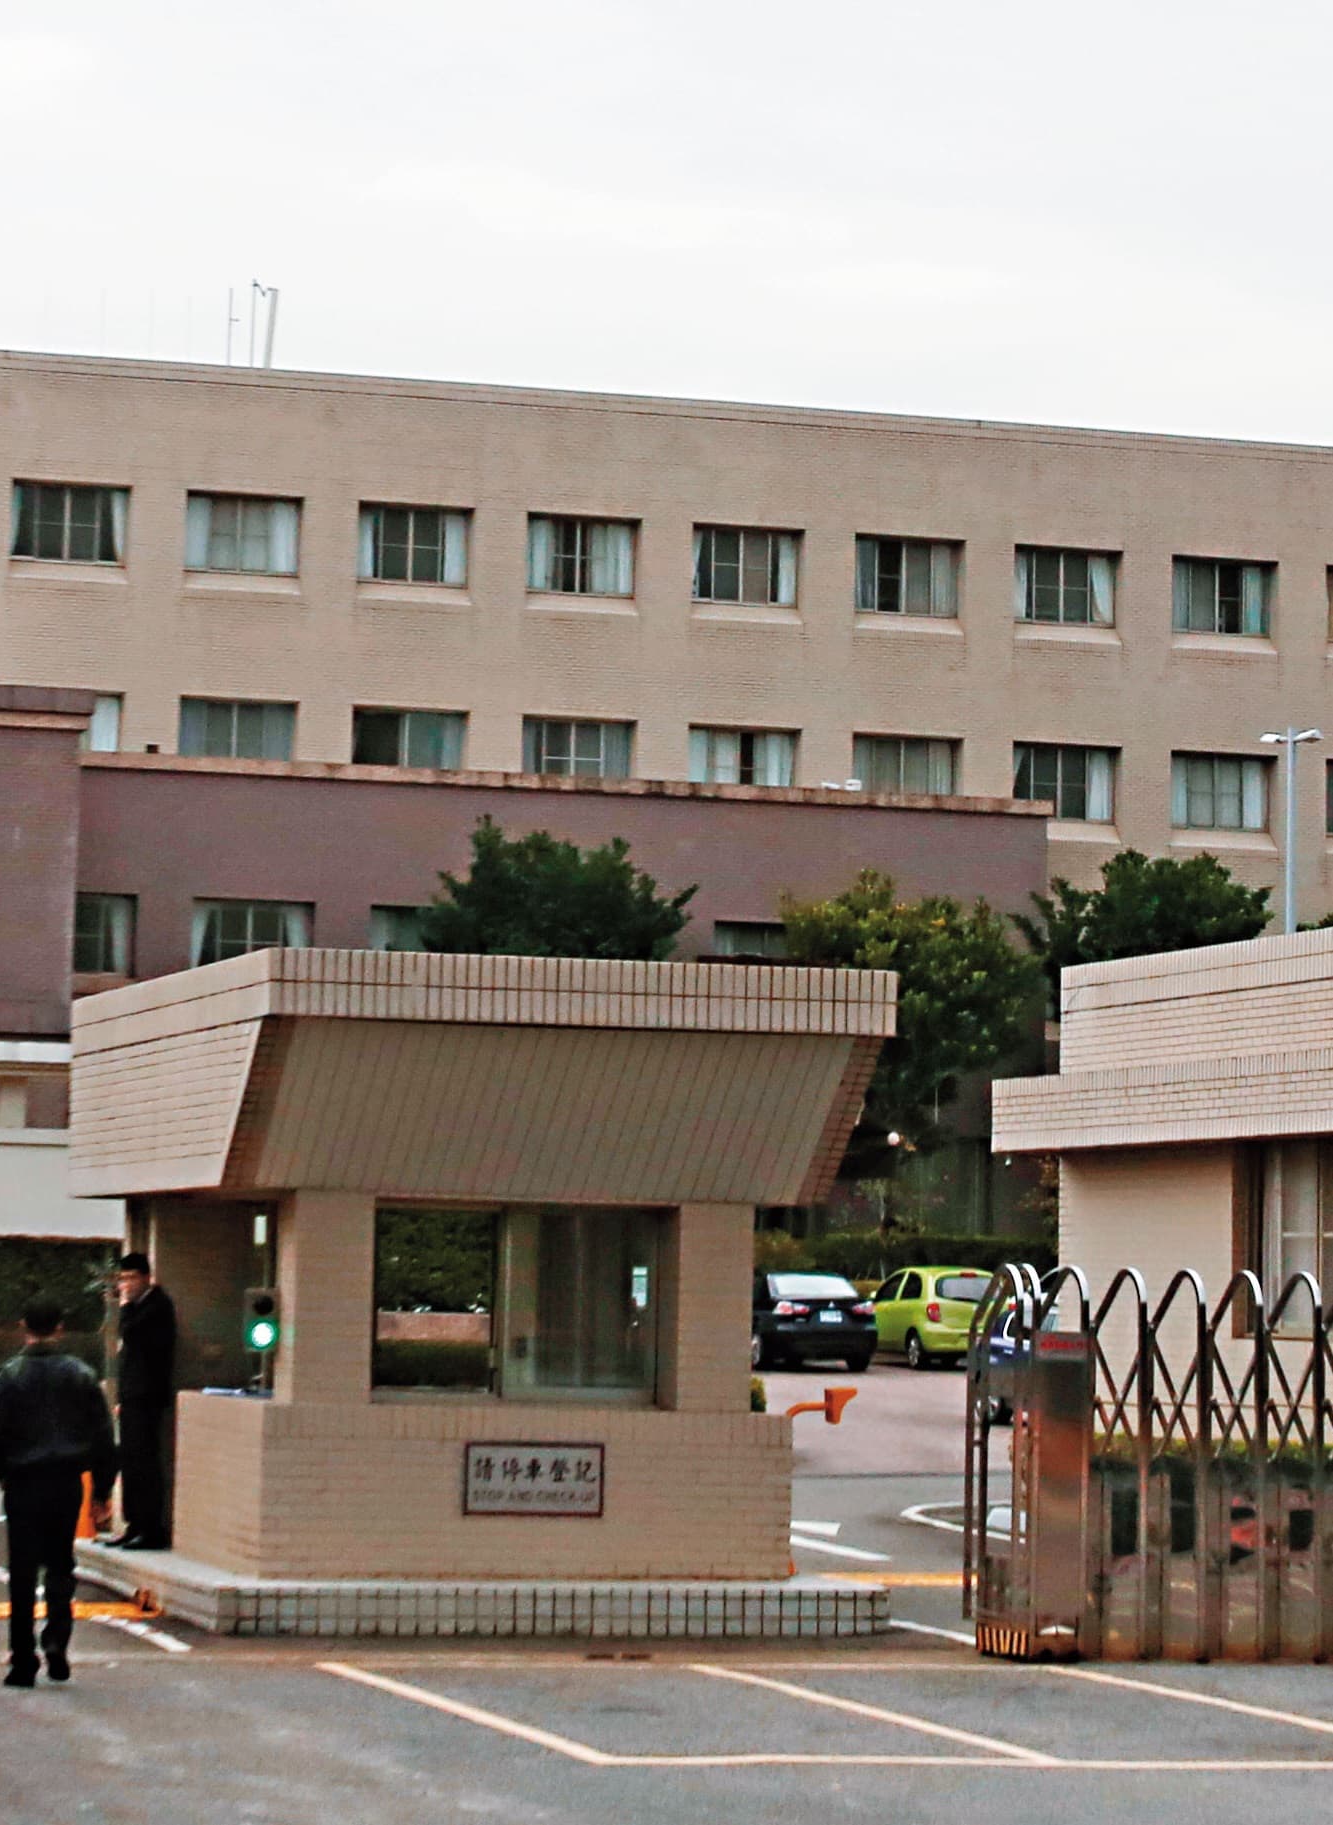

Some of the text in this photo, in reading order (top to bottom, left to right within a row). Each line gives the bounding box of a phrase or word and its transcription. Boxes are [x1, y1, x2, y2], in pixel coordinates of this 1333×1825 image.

[473, 1456, 597, 1483] 請停車登記
[473, 1489, 504, 1502] STOP
